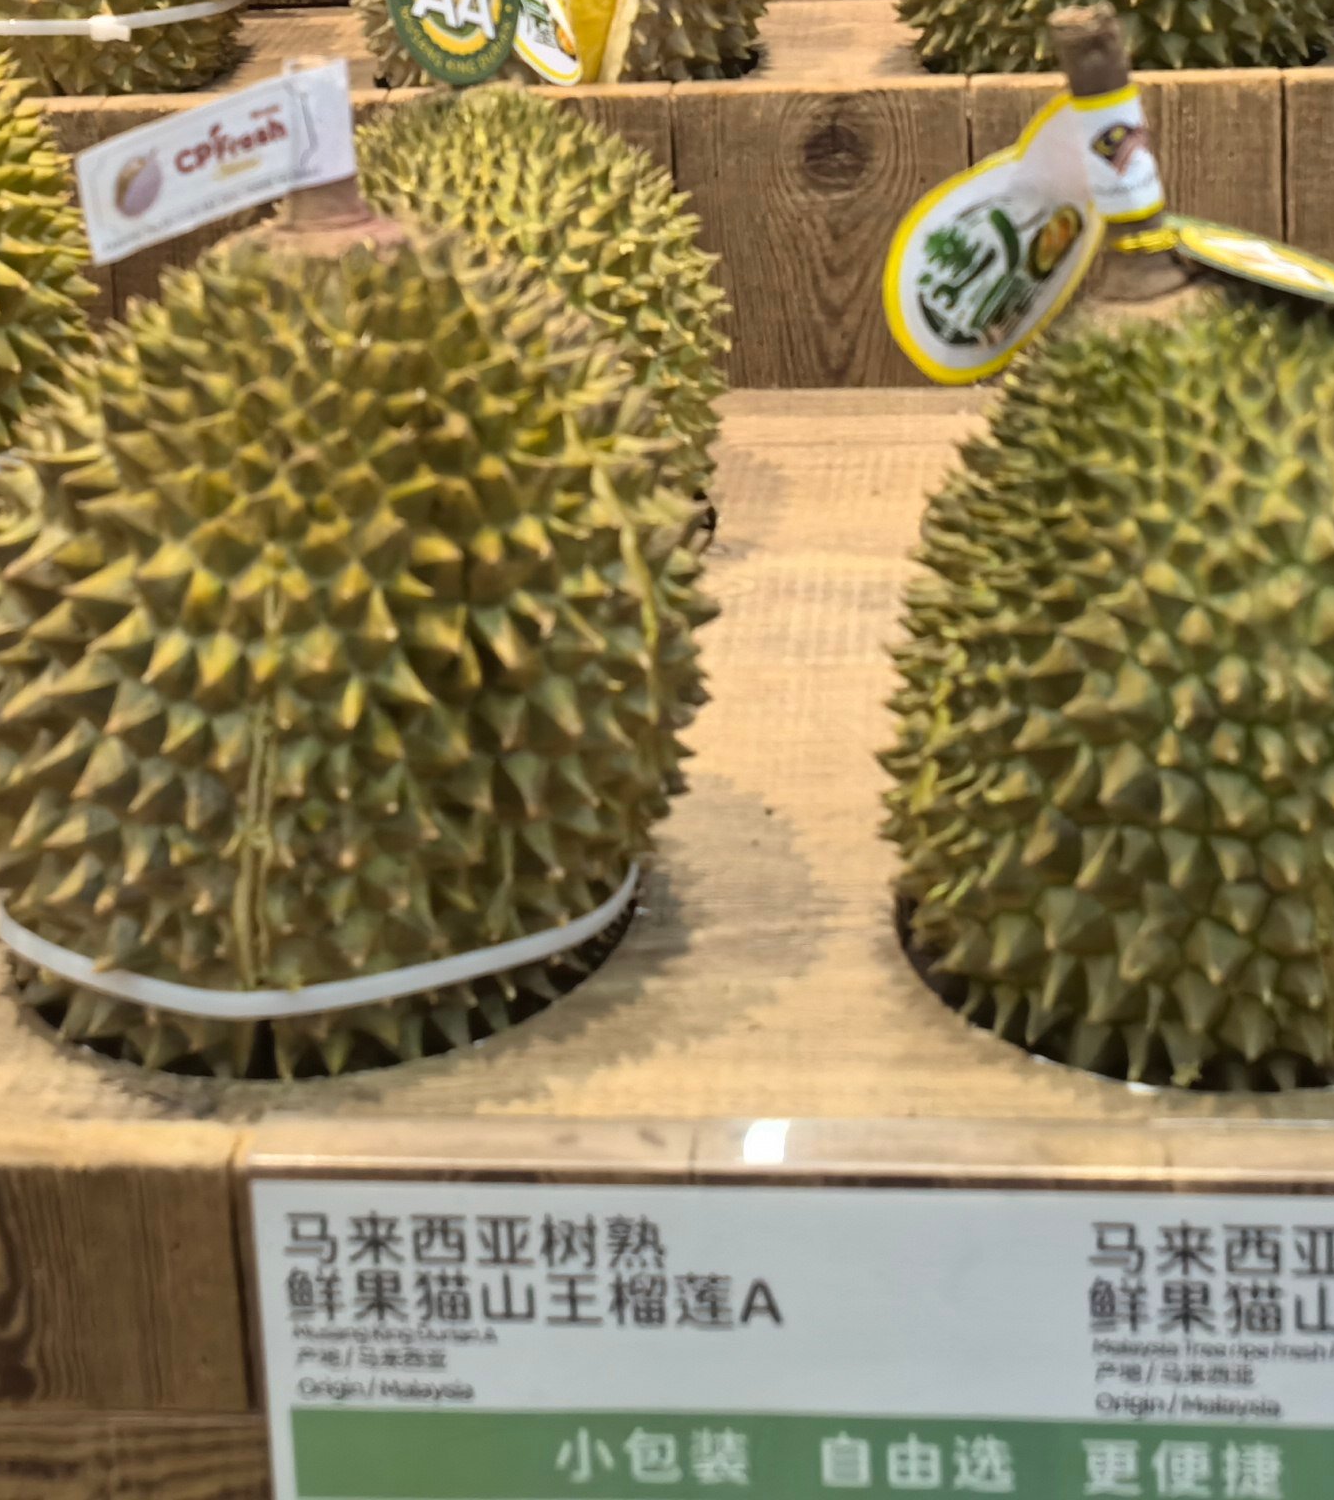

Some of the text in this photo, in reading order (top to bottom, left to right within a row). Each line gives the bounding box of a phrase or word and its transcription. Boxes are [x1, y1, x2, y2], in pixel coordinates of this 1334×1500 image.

[283, 1211, 667, 1269] 马来西亚树熟
[284, 1268, 784, 1328] 鲜果猫山王榴莲A
[556, 1427, 752, 1488] 小包装
[819, 1434, 1018, 1494] 自由选
[1081, 1437, 1285, 1499] 更便捷
